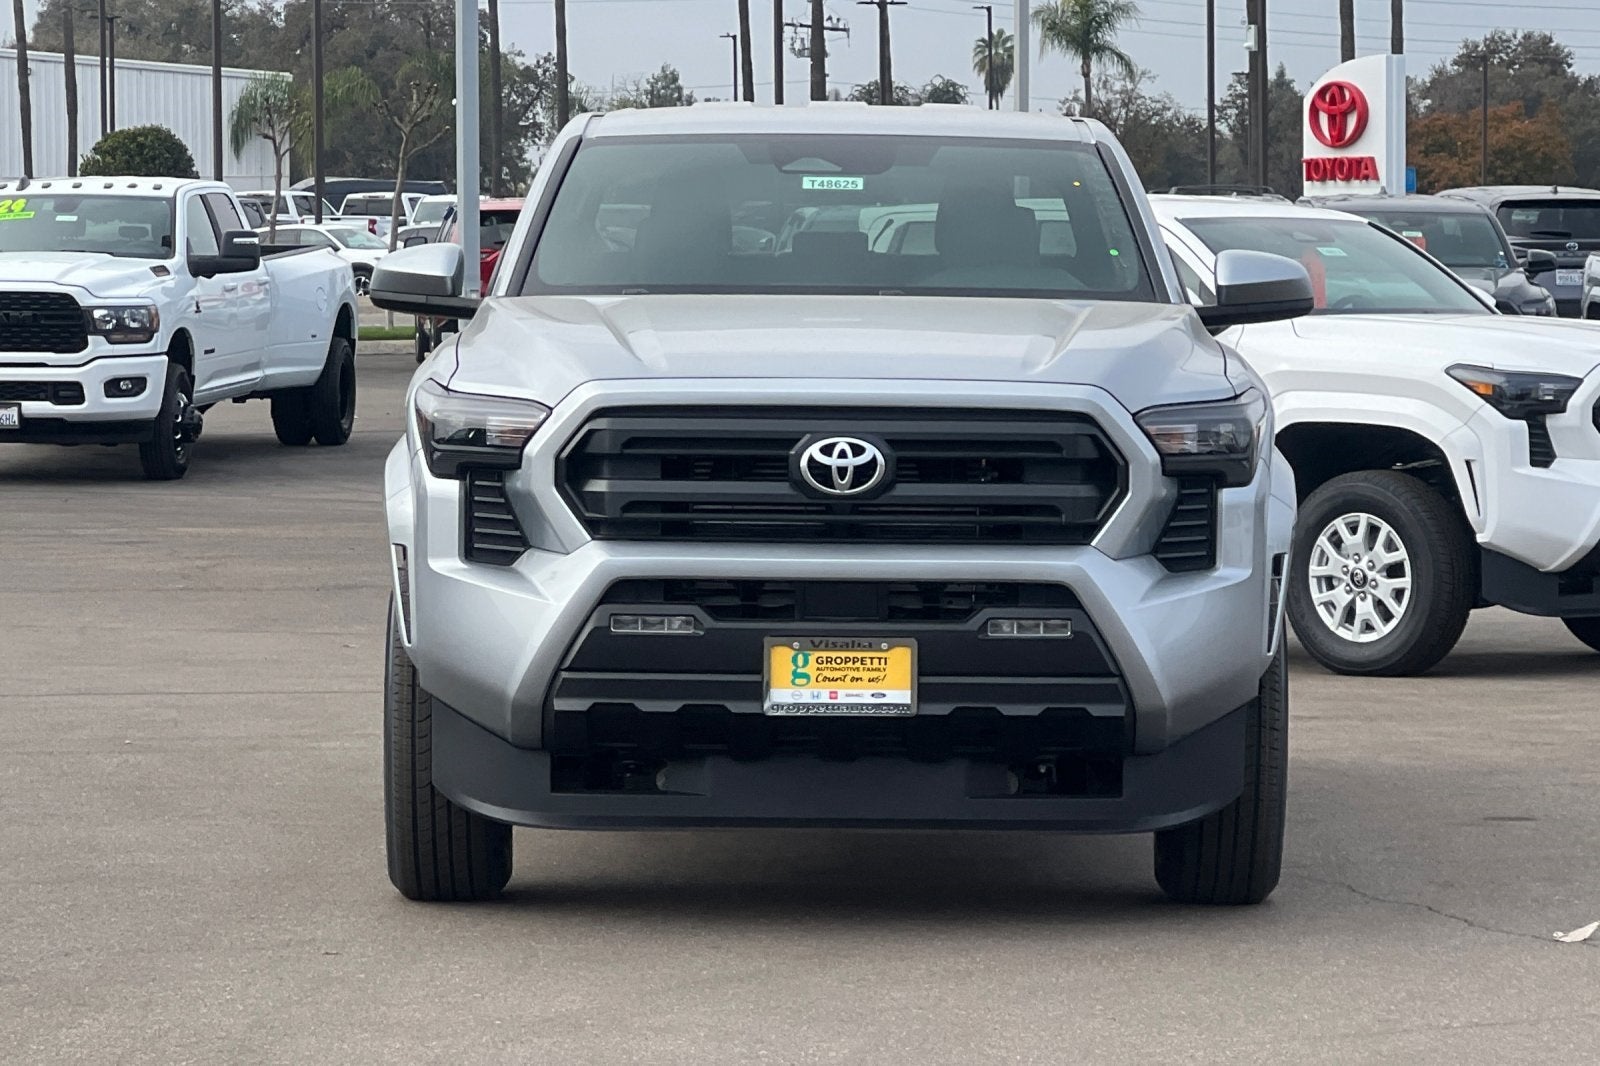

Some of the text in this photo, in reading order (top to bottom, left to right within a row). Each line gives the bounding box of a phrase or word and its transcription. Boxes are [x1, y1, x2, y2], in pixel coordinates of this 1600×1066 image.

[1301, 156, 1380, 182] TOYOTA
[808, 179, 859, 189] T48625
[809, 639, 873, 649] Visalia
[815, 656, 888, 666] GROPPETTI
[815, 673, 847, 684] Count
[867, 673, 887, 684] us!
